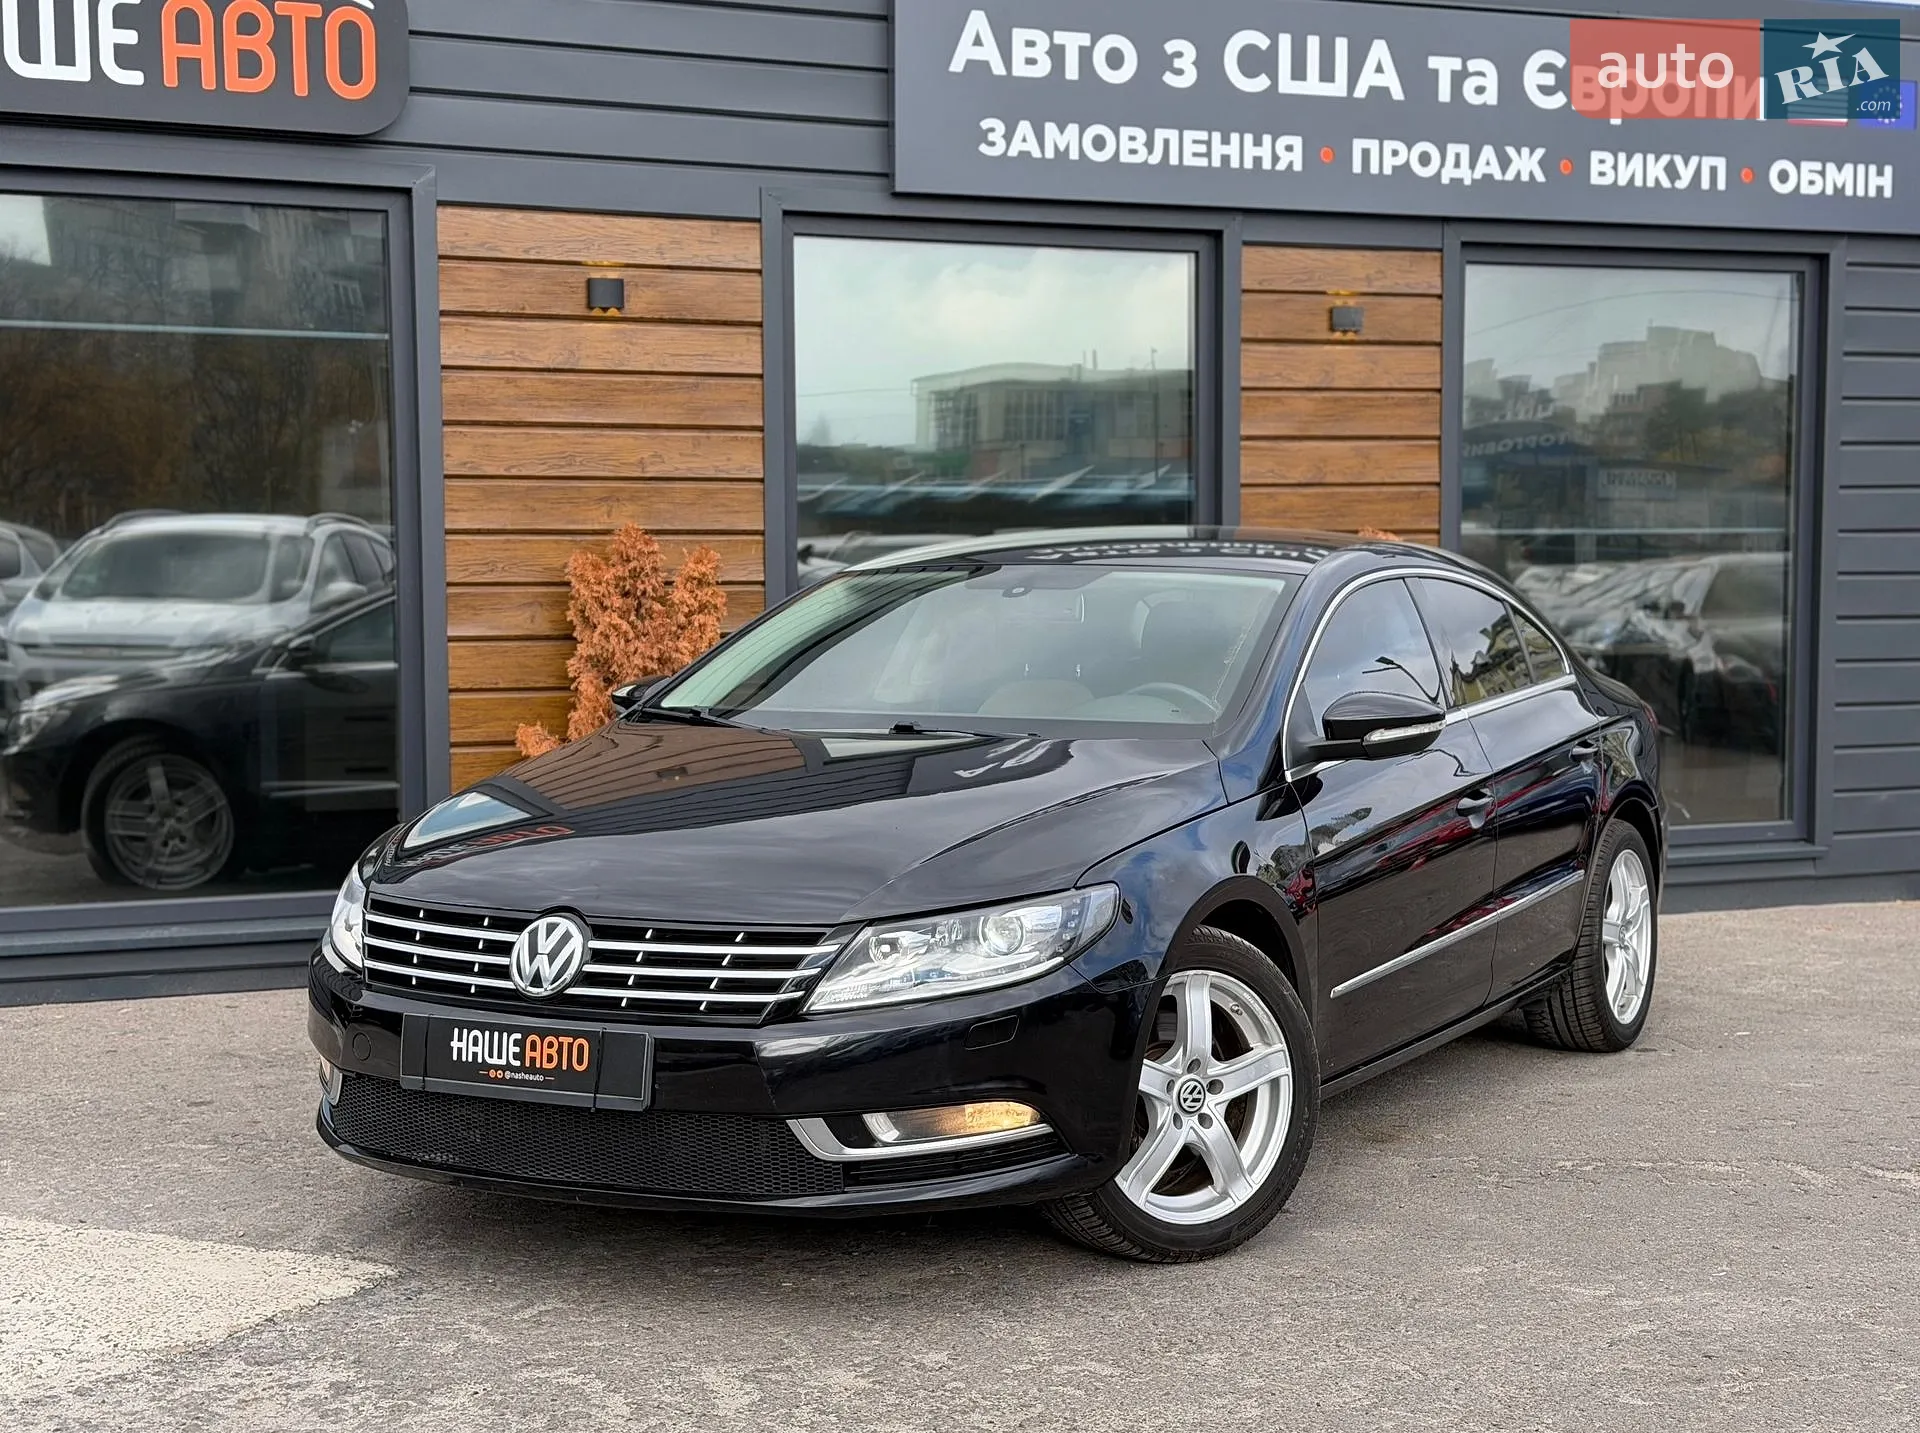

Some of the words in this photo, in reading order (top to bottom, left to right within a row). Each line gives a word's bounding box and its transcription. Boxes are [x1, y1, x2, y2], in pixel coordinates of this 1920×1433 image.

[161, 0, 377, 100] АВТО
[948, 8, 1138, 85] Авто
[1161, 38, 1198, 89] з
[1222, 28, 1406, 101] США
[1427, 54, 1499, 106] та
[977, 117, 1304, 172] ЗАМОВЛЕННЯ
[1352, 137, 1547, 186] ПРОДАЖ
[1589, 149, 1727, 192] ВИКУП
[1767, 159, 1895, 199] ОБМІН
[450, 1027, 522, 1067] НАШЕ
[525, 1033, 590, 1072] АВТО
[504, 1070, 545, 1082] @nasheauto
